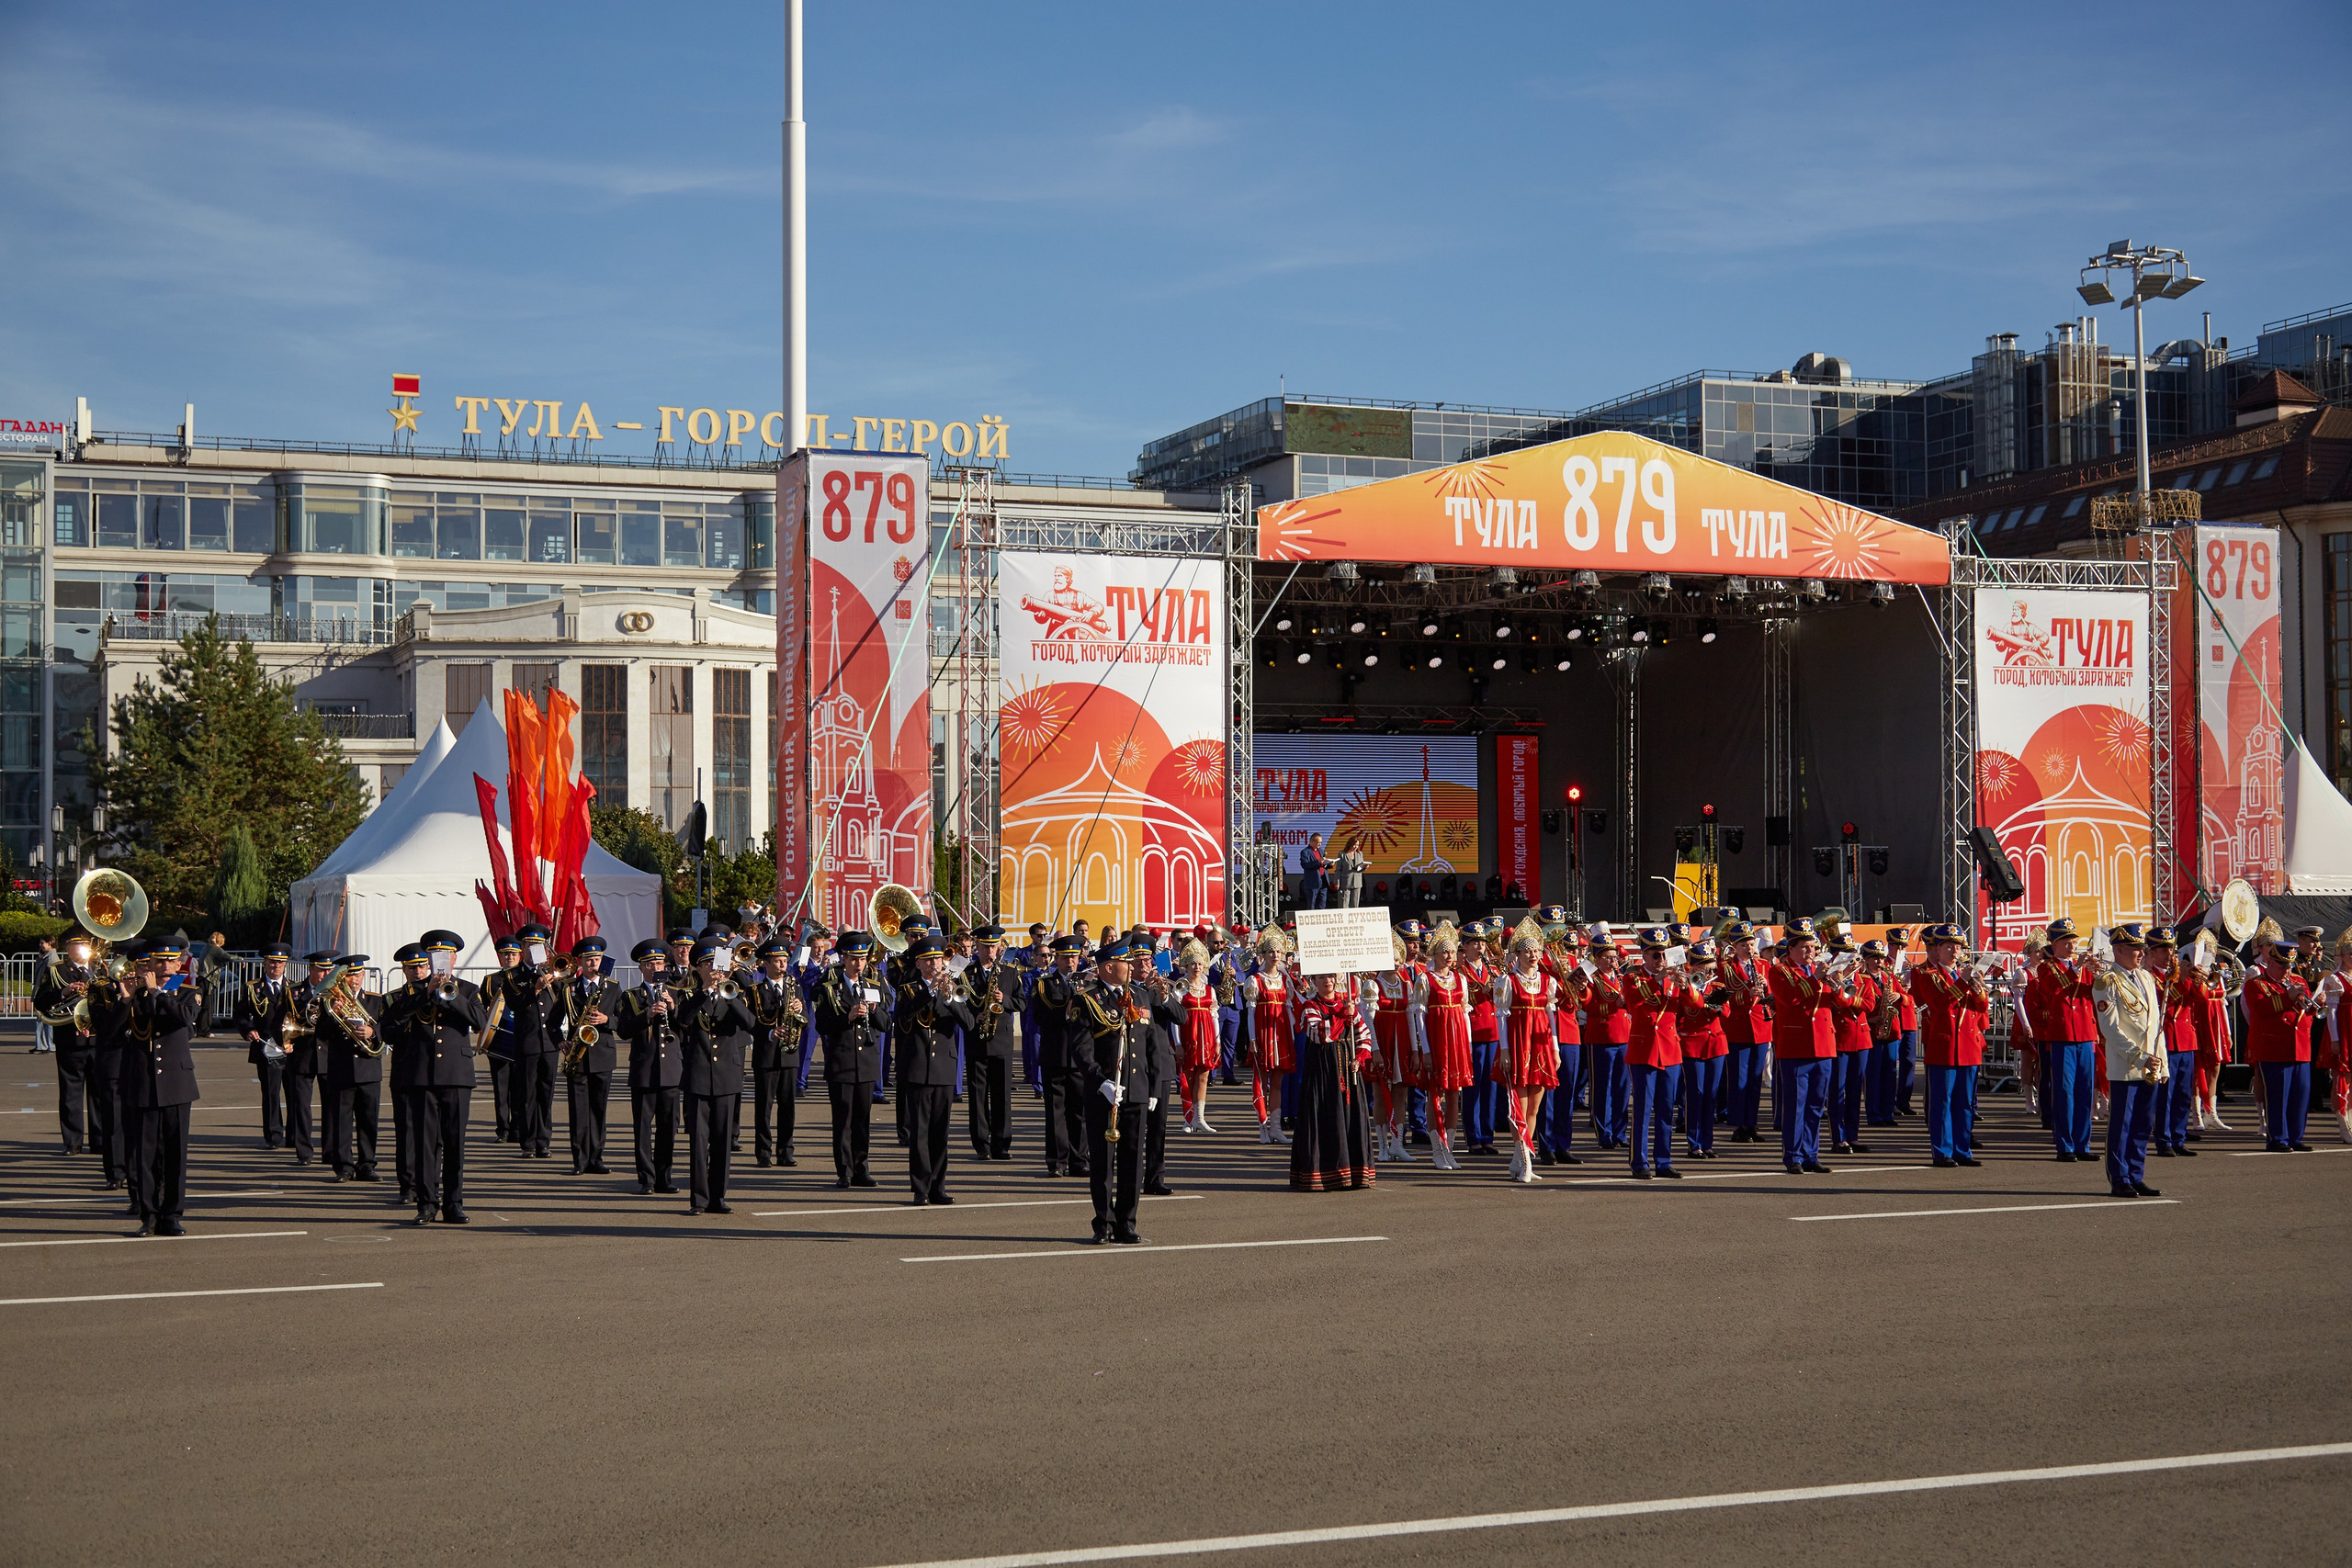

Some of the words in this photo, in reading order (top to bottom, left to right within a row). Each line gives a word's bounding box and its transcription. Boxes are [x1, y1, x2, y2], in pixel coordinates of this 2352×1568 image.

[455, 395, 604, 440] ТУЛА
[822, 469, 916, 545] 879
[1445, 496, 1538, 549] ТУЛА
[1562, 455, 1677, 555] 879
[1701, 508, 1788, 558] ТУЛА
[785, 487, 796, 579] ГОРОД!
[2206, 539, 2271, 601] 879
[1105, 585, 1211, 645] ТУЛА
[784, 586, 796, 721] ЛЮБИМЫЙ
[1031, 642, 1079, 665] ГОРОД,
[1080, 641, 1142, 664] КОТОРЫЙ
[1144, 646, 1212, 666] ЗАРЯЖАЕТ
[2051, 618, 2133, 668] ТУЛА
[1994, 669, 2028, 688] ГОРОД,
[2030, 667, 2077, 686] КОТОРЫЙ
[2078, 671, 2133, 687] ЗАРЯЖАЕТ
[1512, 739, 1525, 772] ГОРОД!
[1256, 768, 1328, 801] ТУЛА
[1512, 774, 1525, 821] ЛЮБИМЫЙ
[1514, 824, 1527, 875] РОЖДЕНИЯ,
[1298, 912, 1344, 926] ВОЕННЫЙ
[1348, 910, 1389, 924] ДУХОВОЙ
[1326, 926, 1365, 937] ОРКЕСТР
[1304, 940, 1341, 949] АКАДЕМИИ
[1343, 937, 1389, 946] ФЕДЕРАЛЬНОЙ
[1305, 949, 1335, 958] СЛУЖБЫ
[1337, 947, 1364, 956] ОХРАНЫ
[1366, 946, 1390, 954] РОССИИ
[1340, 960, 1358, 969] ОРЕЛ
